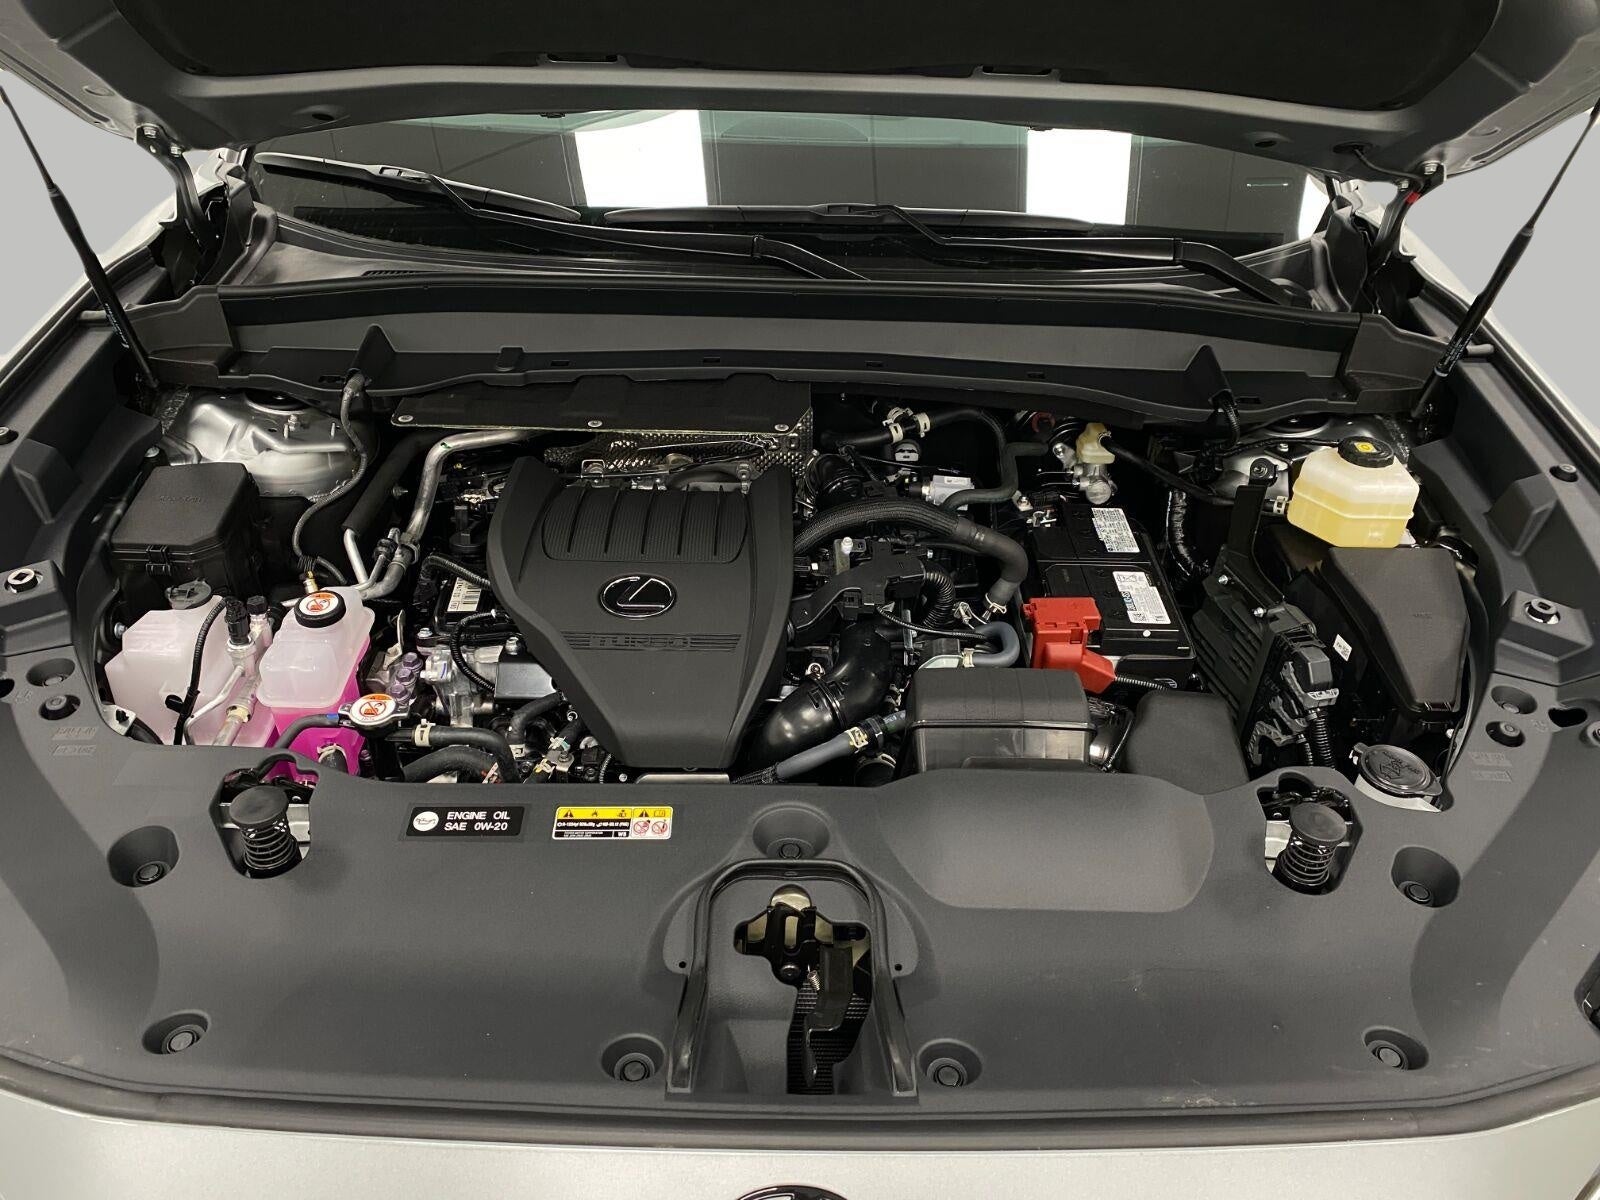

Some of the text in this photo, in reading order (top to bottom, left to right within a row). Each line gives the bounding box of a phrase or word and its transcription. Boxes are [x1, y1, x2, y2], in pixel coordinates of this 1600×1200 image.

[591, 634, 690, 650] TURBO
[446, 811, 511, 820] ENGINE OIL
[444, 821, 508, 831] SAE 0W-20
